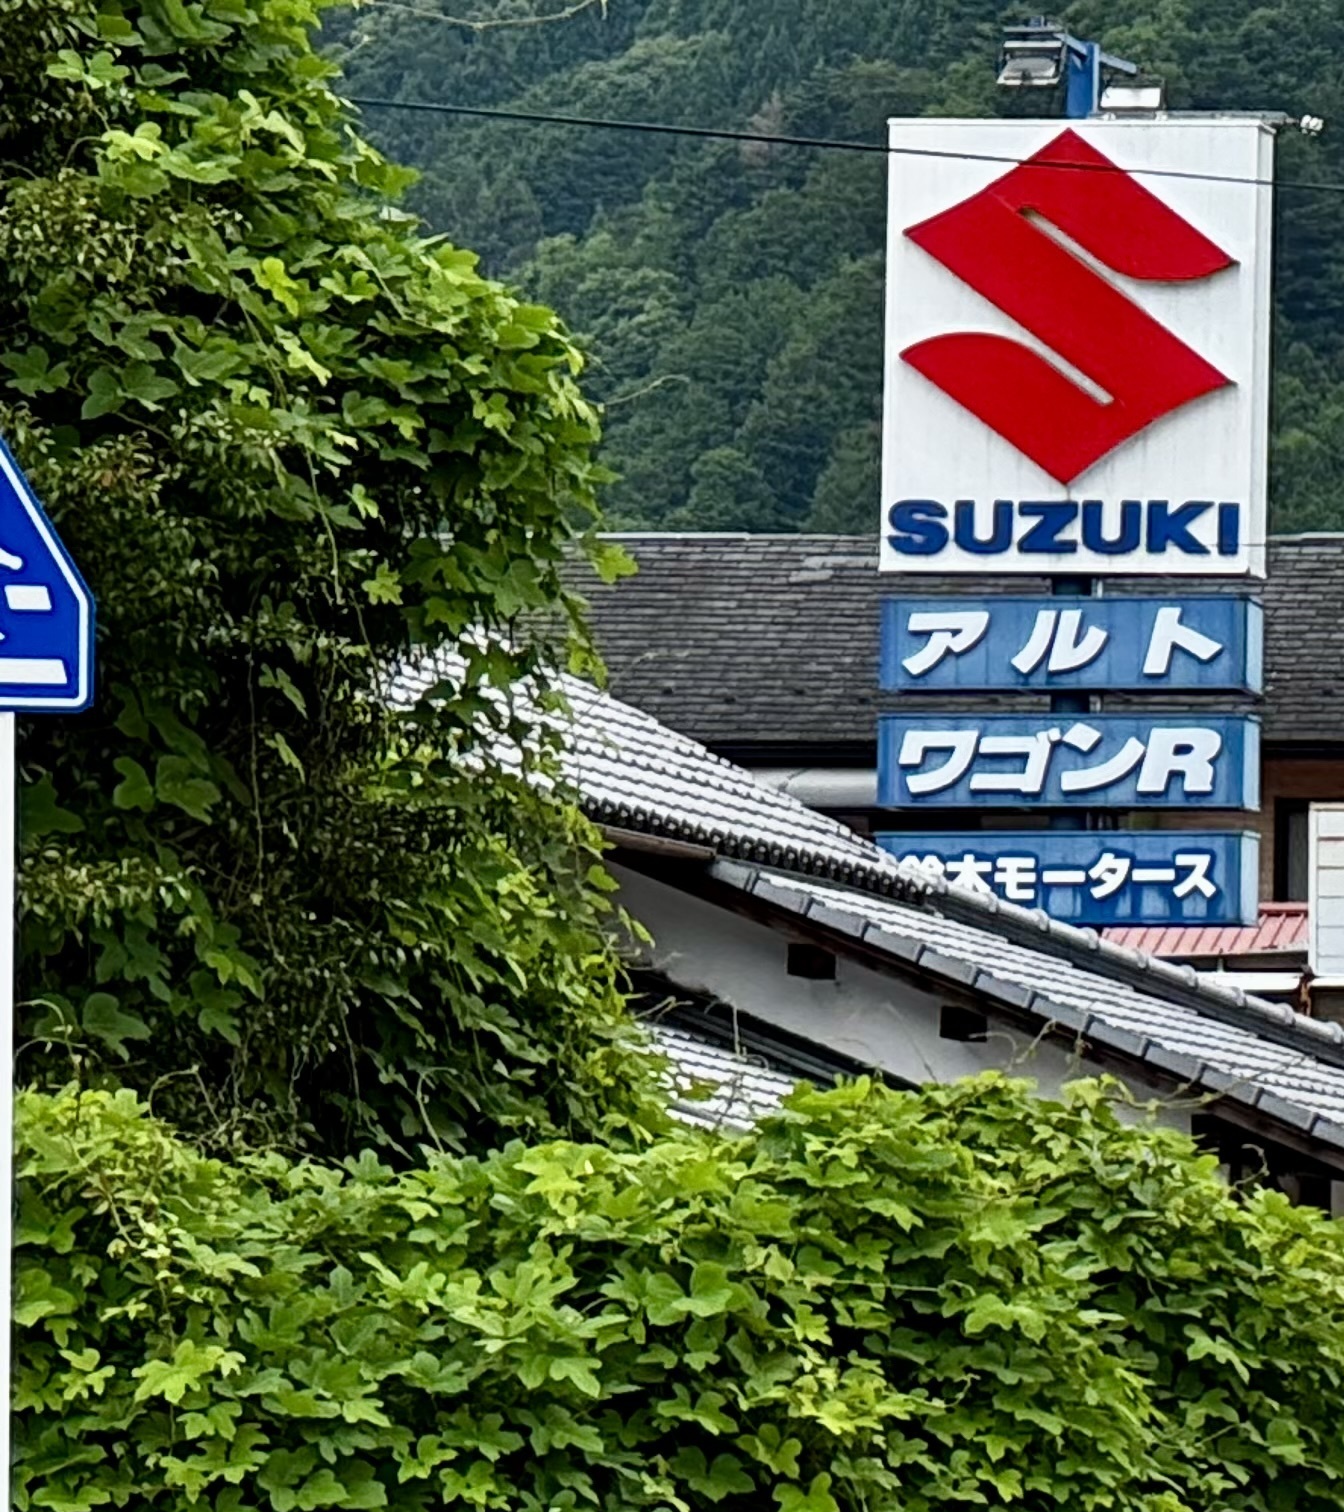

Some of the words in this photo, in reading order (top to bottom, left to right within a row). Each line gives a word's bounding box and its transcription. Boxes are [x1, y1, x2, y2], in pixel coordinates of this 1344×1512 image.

[887, 500, 1240, 555] SUZUKI
[902, 606, 1224, 676] アルト
[898, 722, 1222, 793] ワゴンR
